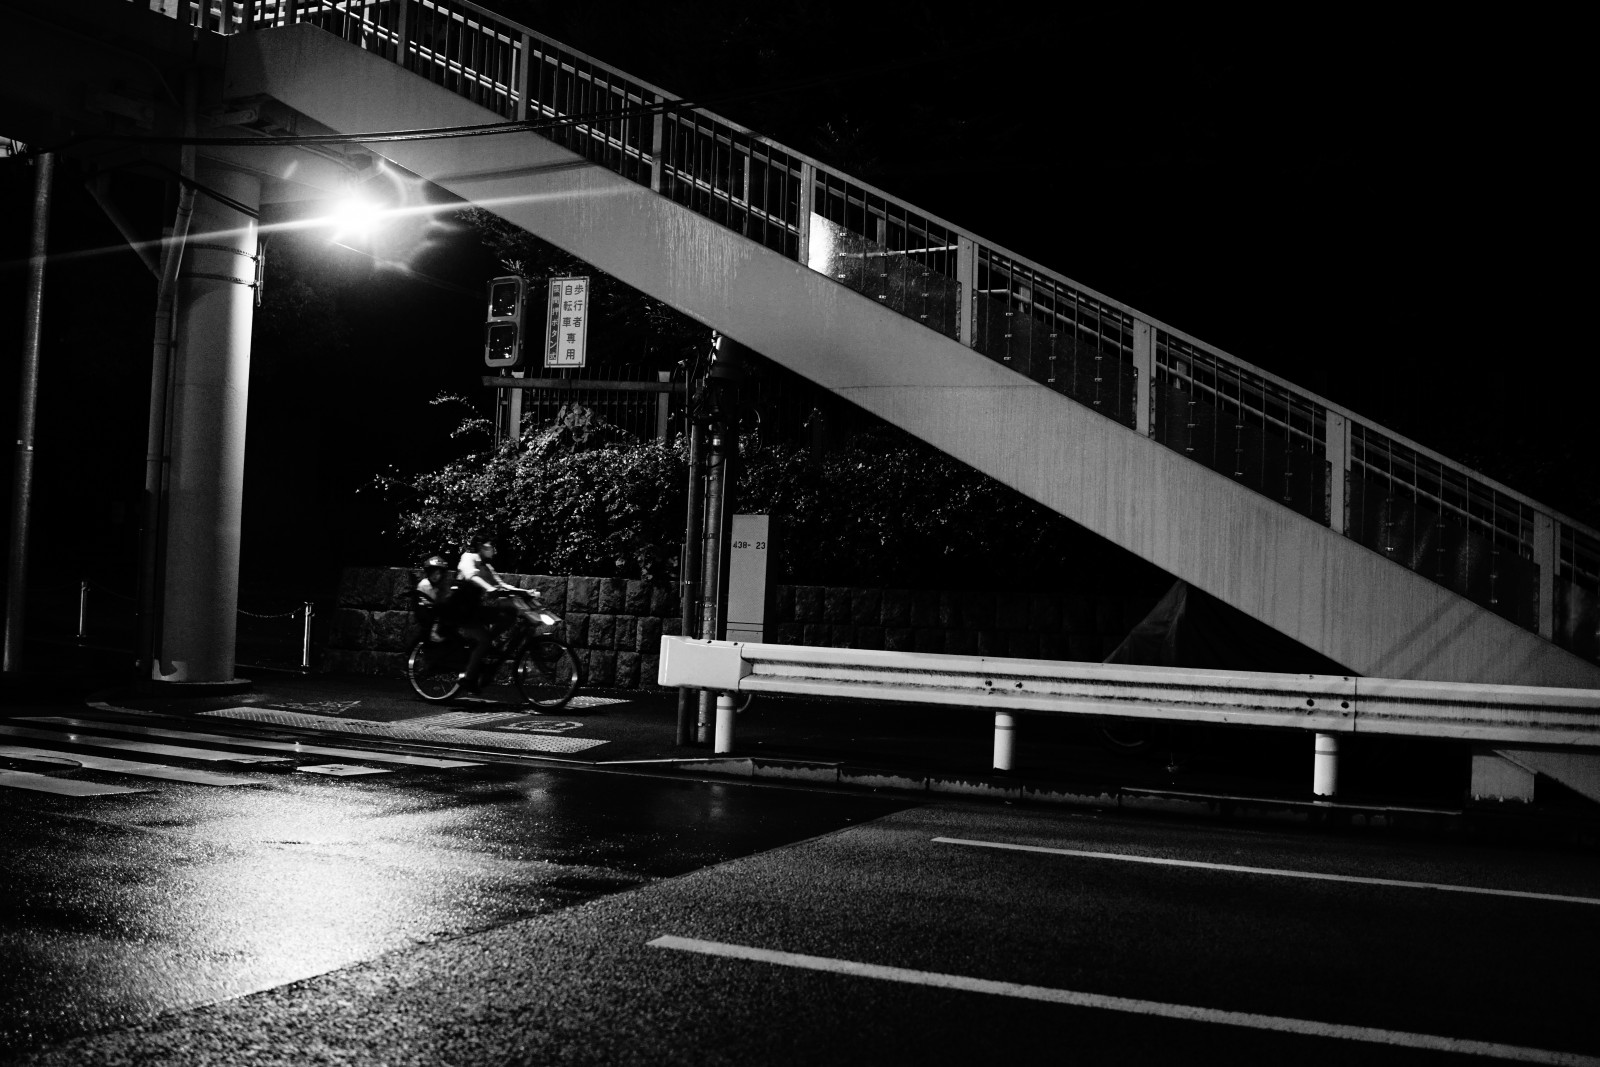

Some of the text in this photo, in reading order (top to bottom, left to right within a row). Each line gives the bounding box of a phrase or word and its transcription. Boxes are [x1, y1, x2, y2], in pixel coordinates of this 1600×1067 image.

[562, 285, 573, 328] 自転車
[572, 284, 584, 328] 歩行者
[565, 332, 576, 360] 専用
[755, 541, 765, 550] 23
